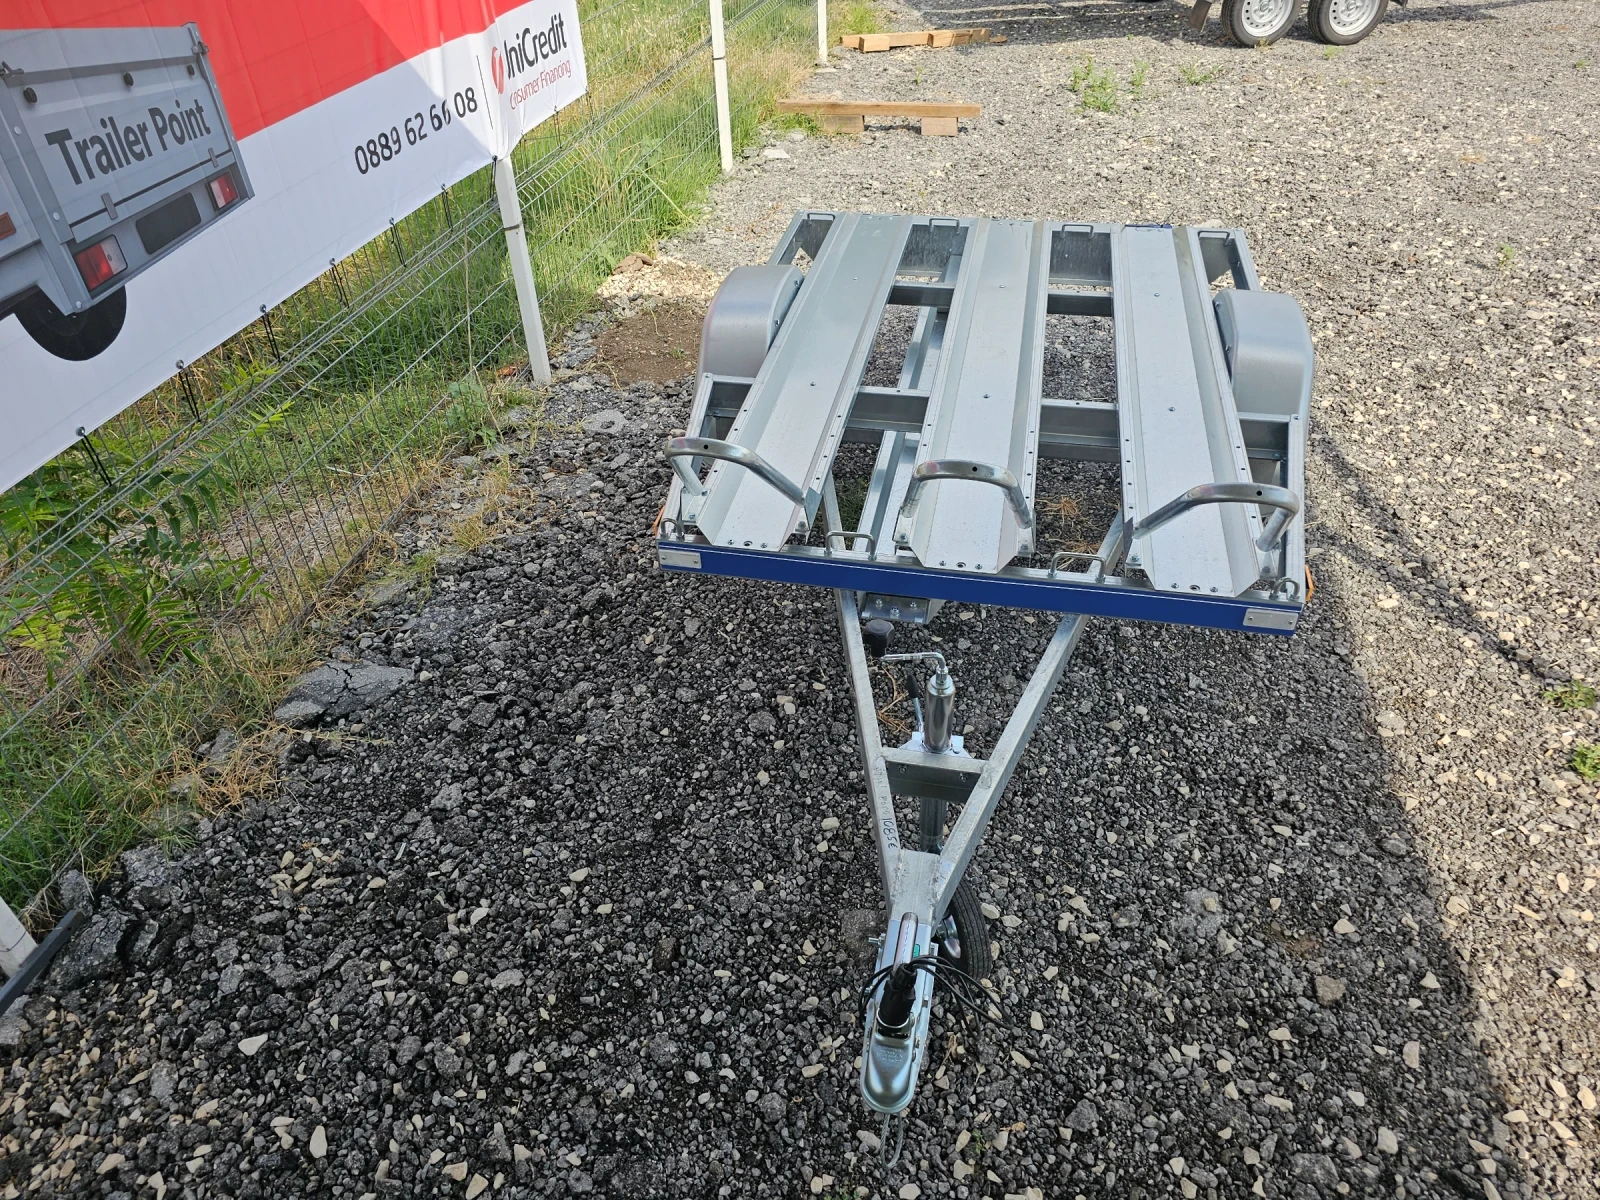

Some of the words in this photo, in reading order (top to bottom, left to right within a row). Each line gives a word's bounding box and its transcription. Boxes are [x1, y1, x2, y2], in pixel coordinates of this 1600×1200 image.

[509, 78, 541, 110] Cnsumer
[540, 60, 572, 88] Financing
[44, 116, 153, 186] Trailer
[148, 99, 212, 151] Point
[354, 126, 402, 174] 0889
[404, 112, 428, 146] 62
[429, 98, 452, 131] 66
[454, 87, 478, 118] 08
